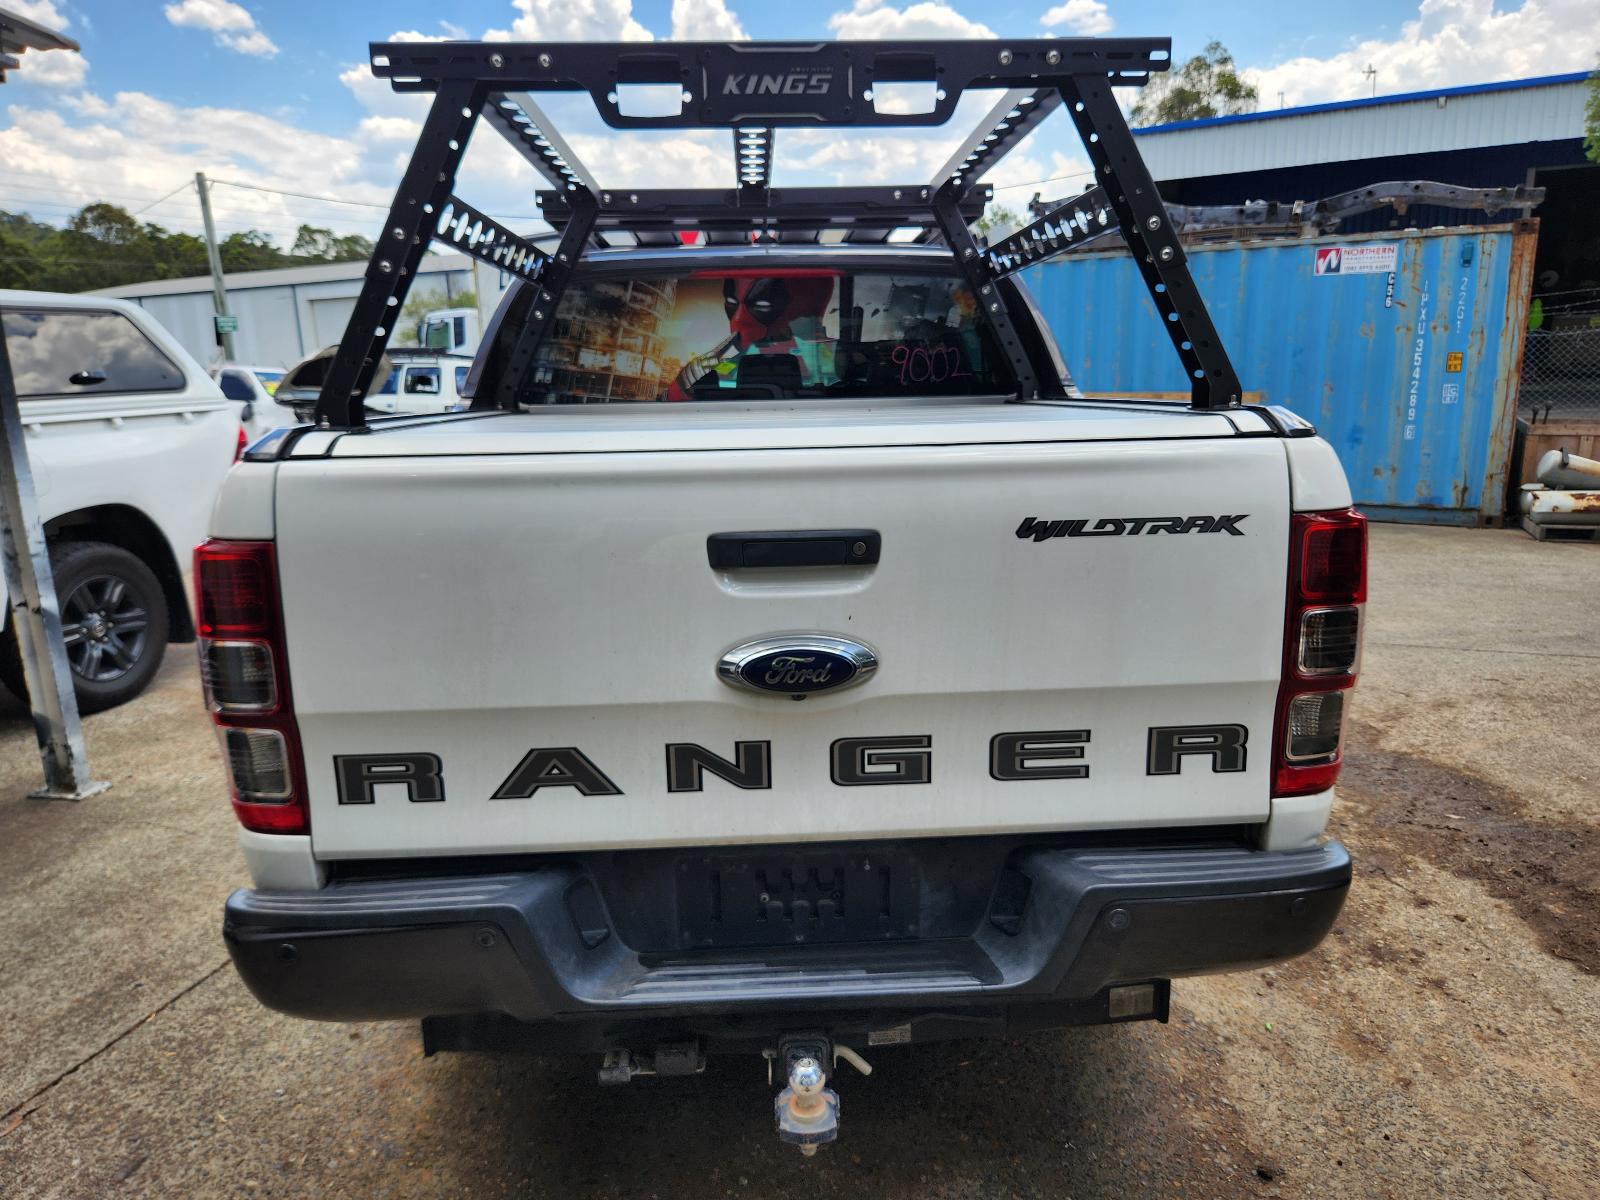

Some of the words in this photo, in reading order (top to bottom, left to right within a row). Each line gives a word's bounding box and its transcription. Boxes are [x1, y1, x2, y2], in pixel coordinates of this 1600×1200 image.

[722, 74, 833, 95] KINGS
[1343, 247, 1395, 256] NORTHERN
[892, 346, 972, 384] 9002
[1408, 339, 1424, 420] 354289
[1015, 514, 1250, 542] WILDTRAK
[765, 656, 831, 684] Ford
[332, 723, 1248, 805] RANGER
